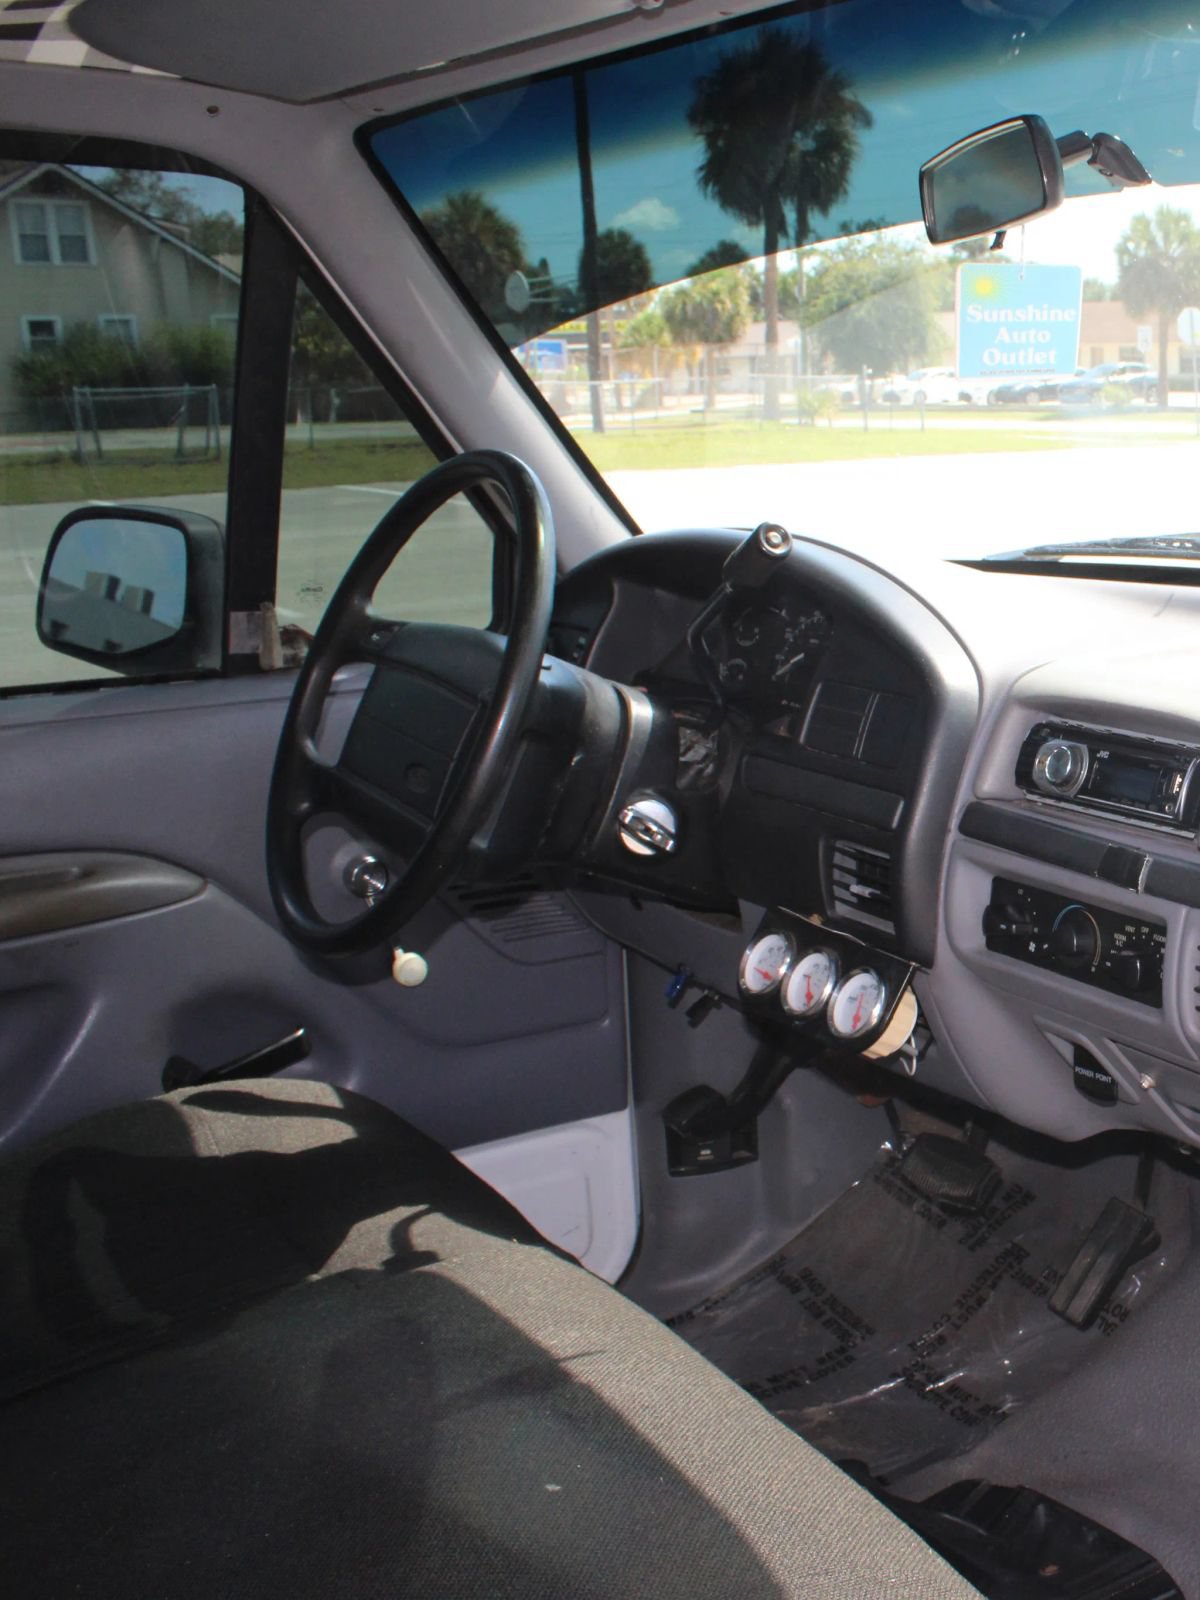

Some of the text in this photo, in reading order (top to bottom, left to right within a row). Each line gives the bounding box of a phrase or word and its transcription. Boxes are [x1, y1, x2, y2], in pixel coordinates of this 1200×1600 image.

[966, 303, 1076, 323] Sunshine
[995, 326, 1051, 344] Auto
[982, 347, 1057, 367] Outlet
[1074, 1065, 1113, 1084] POWER POINT
